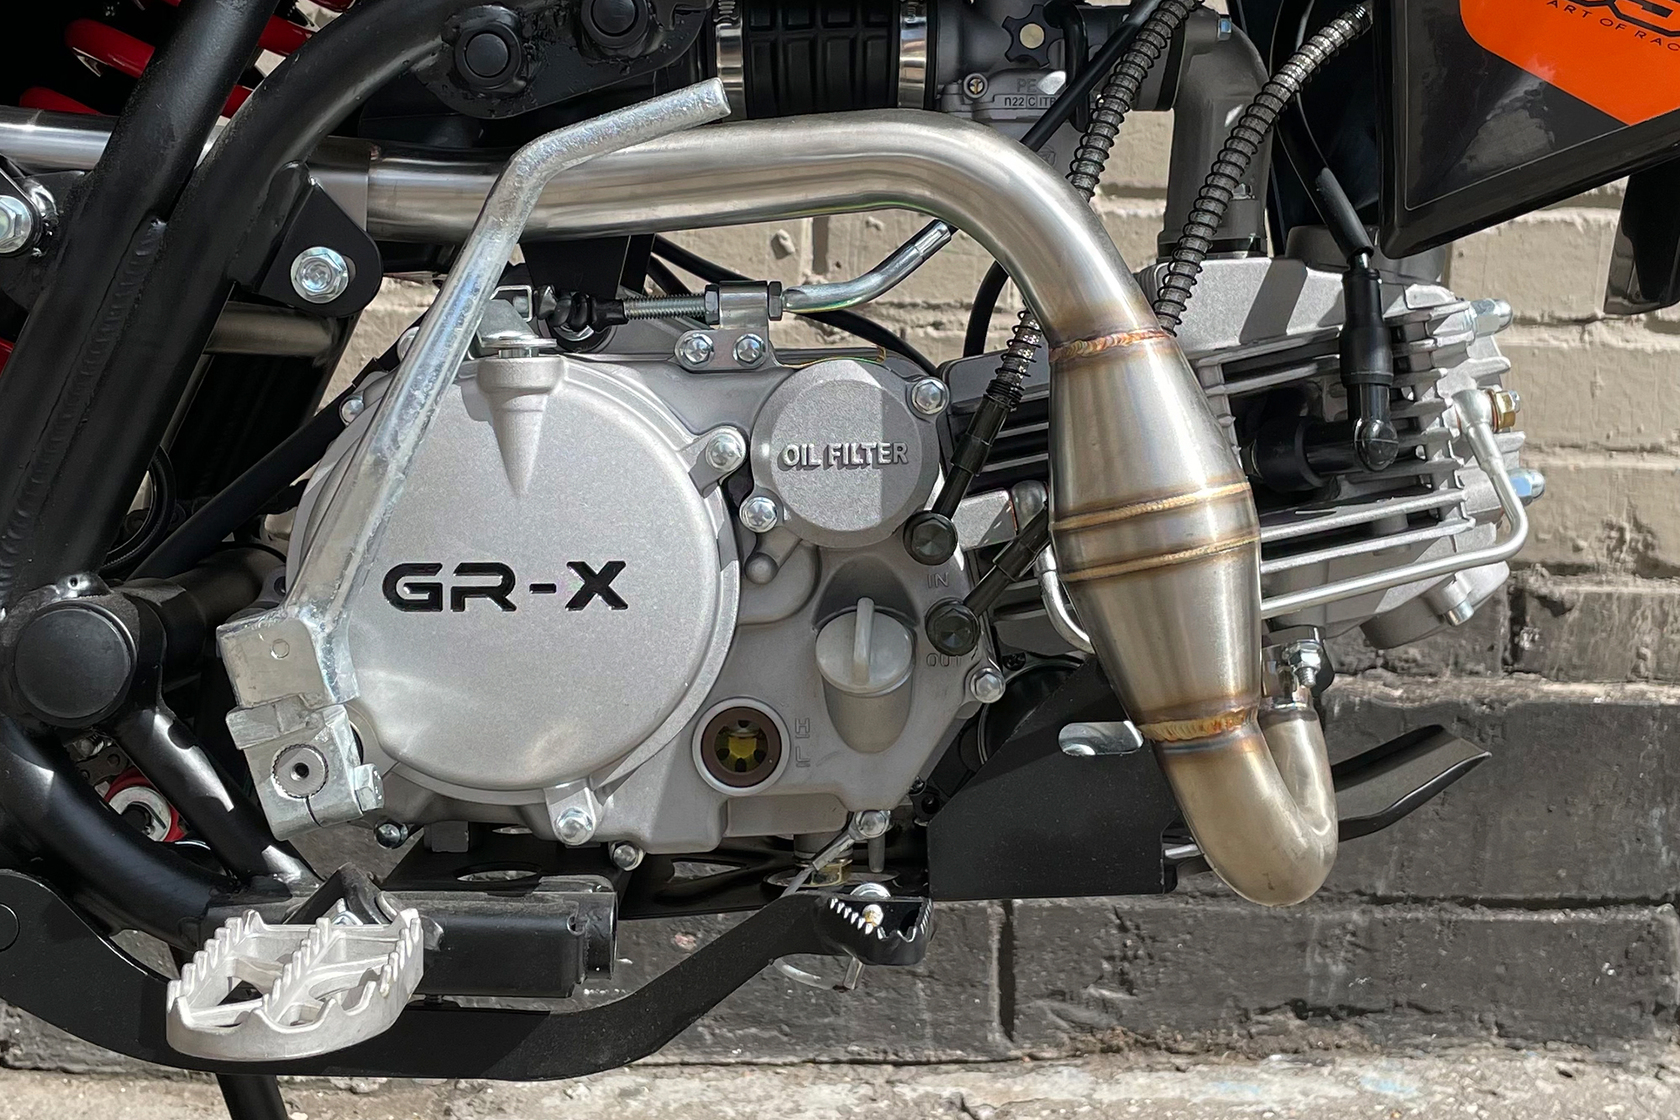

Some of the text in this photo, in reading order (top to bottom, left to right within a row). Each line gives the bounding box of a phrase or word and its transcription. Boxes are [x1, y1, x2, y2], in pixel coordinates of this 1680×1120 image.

[1546, 0, 1593, 18] ART
[1599, 18, 1628, 31] OF
[781, 441, 909, 467] OIL FILTER
[382, 561, 629, 612] GR-X
[926, 572, 949, 588] IN
